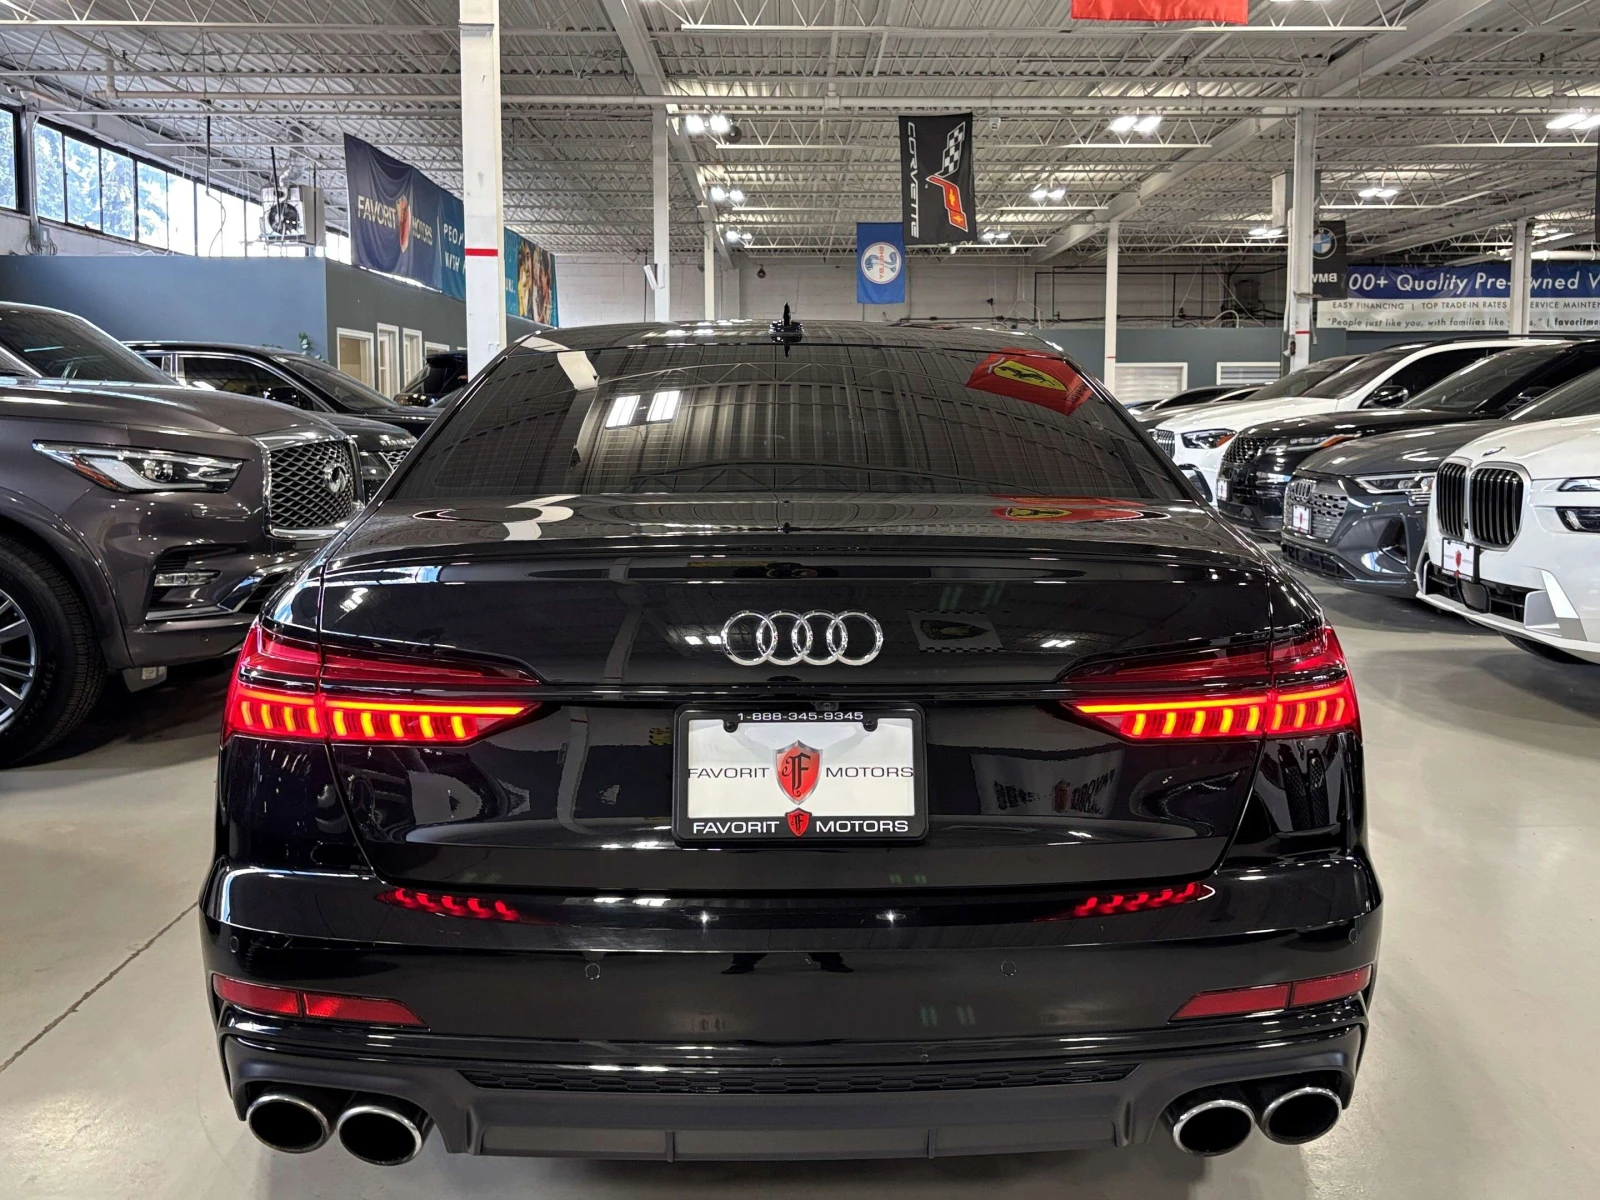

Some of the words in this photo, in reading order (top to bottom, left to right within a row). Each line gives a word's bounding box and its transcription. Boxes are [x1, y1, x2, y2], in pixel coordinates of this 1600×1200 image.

[908, 121, 919, 238] CORVETTE
[357, 195, 396, 229] FAVORIT
[1396, 272, 1468, 295] Quality
[1475, 270, 1580, 290] Pre-wned
[1332, 301, 1353, 309] EASY
[1356, 302, 1405, 310] FINANCING
[1421, 302, 1439, 310] TOP
[1441, 301, 1479, 309] TRADE-IN
[1482, 301, 1507, 309] RATES
[1365, 317, 1383, 328] just
[1385, 318, 1402, 327] like
[1427, 317, 1446, 326] with
[1449, 316, 1485, 326] families
[1488, 316, 1505, 326] like
[1554, 317, 1600, 326] favoritmo
[737, 712, 864, 721] 1-888-345-9345
[688, 767, 770, 779] FAVORIT
[826, 766, 914, 778] MOTORS
[693, 821, 780, 834] FAVORIT
[816, 820, 909, 833] MOTORS
